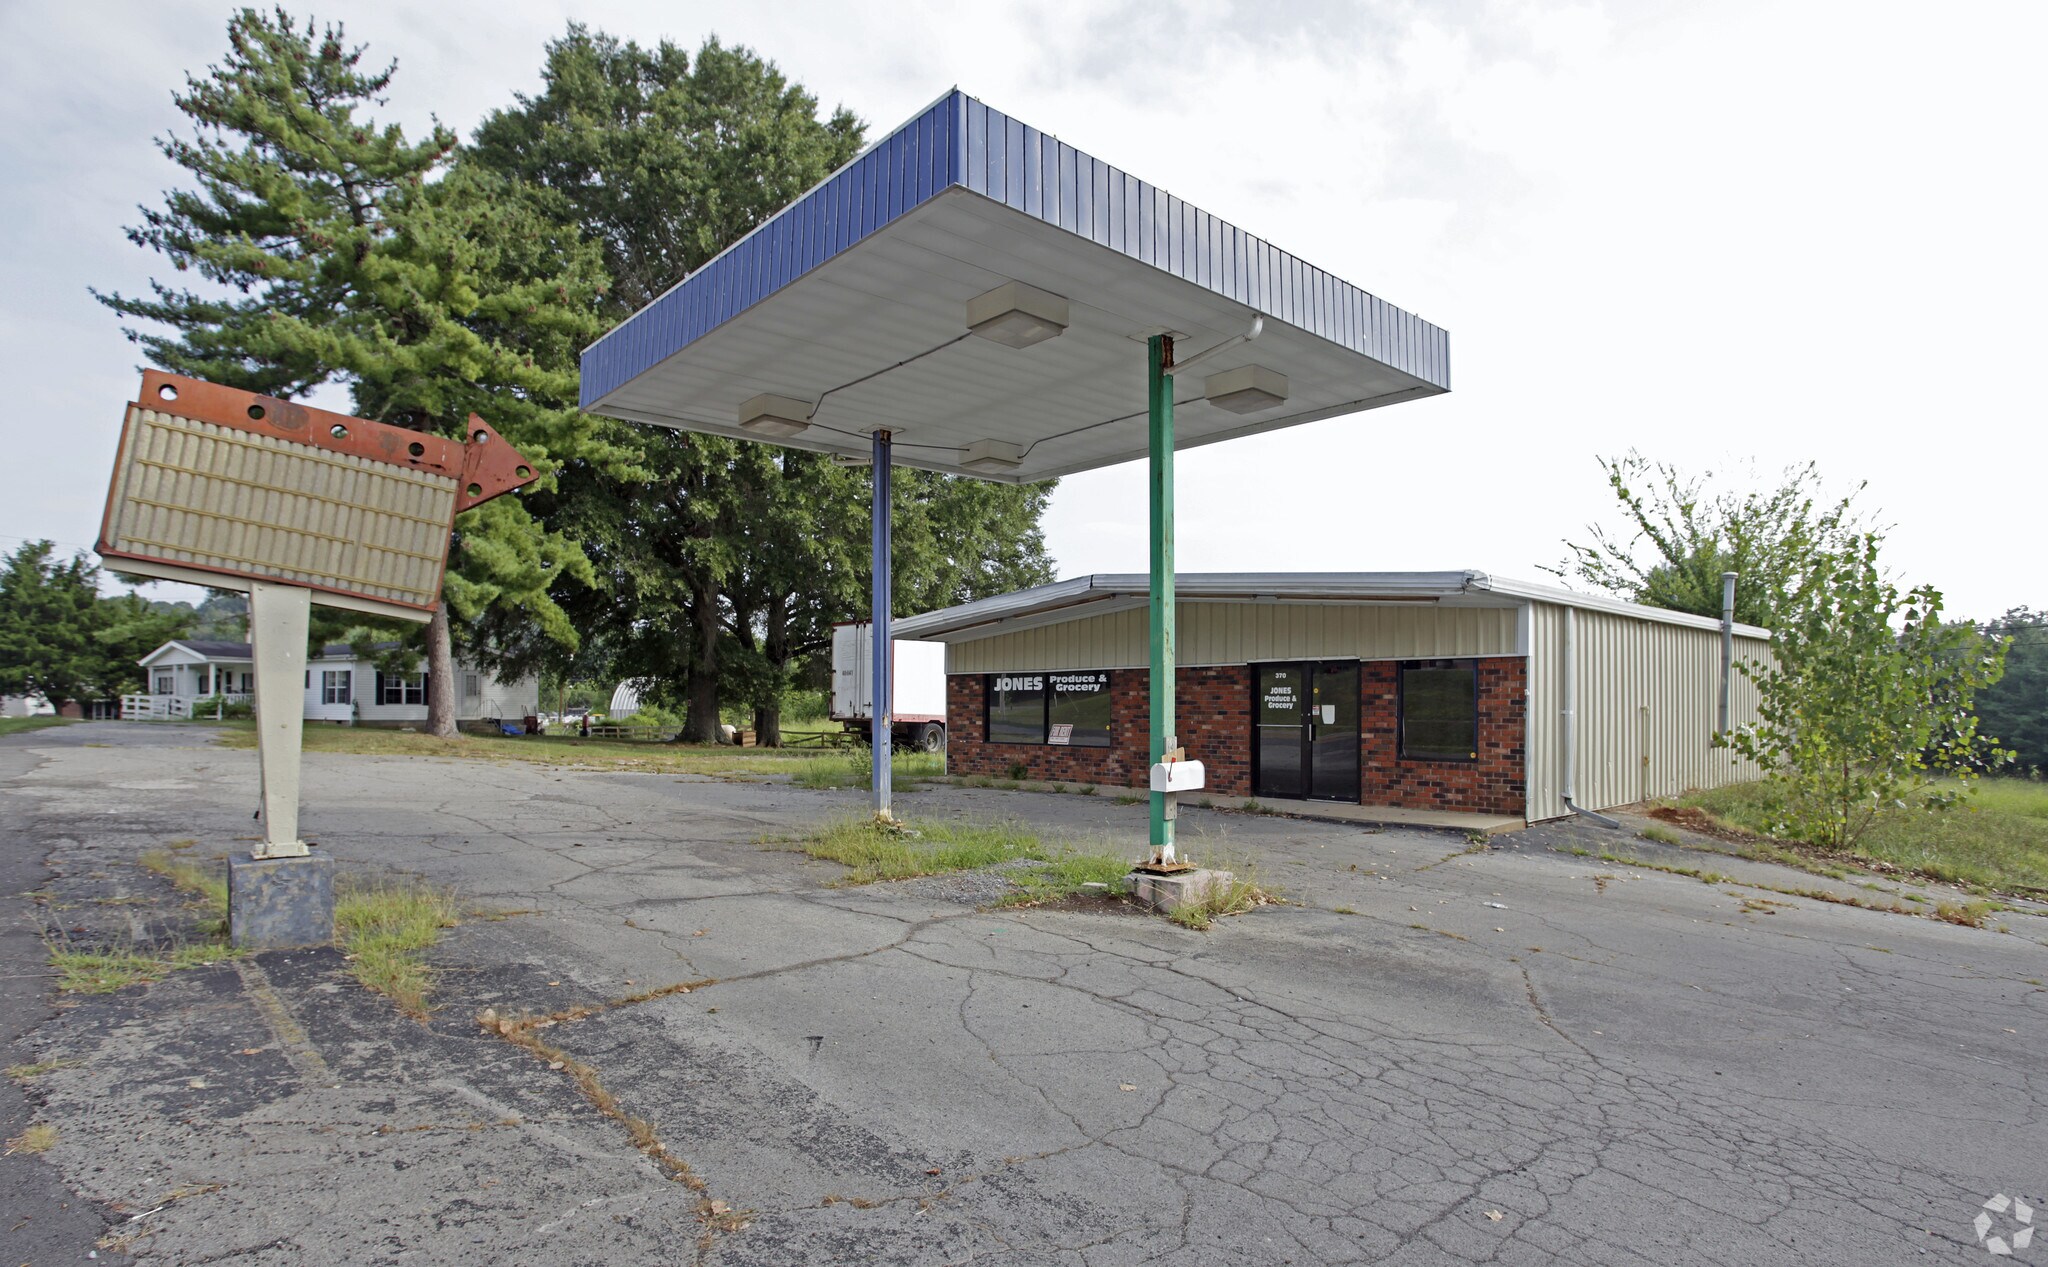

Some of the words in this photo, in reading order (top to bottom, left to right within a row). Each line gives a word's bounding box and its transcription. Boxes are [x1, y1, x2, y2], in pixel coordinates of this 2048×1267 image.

[1050, 675, 1095, 683] Produce
[1099, 674, 1107, 682] &
[994, 677, 1043, 691] JONES
[1056, 683, 1100, 692] Grocery
